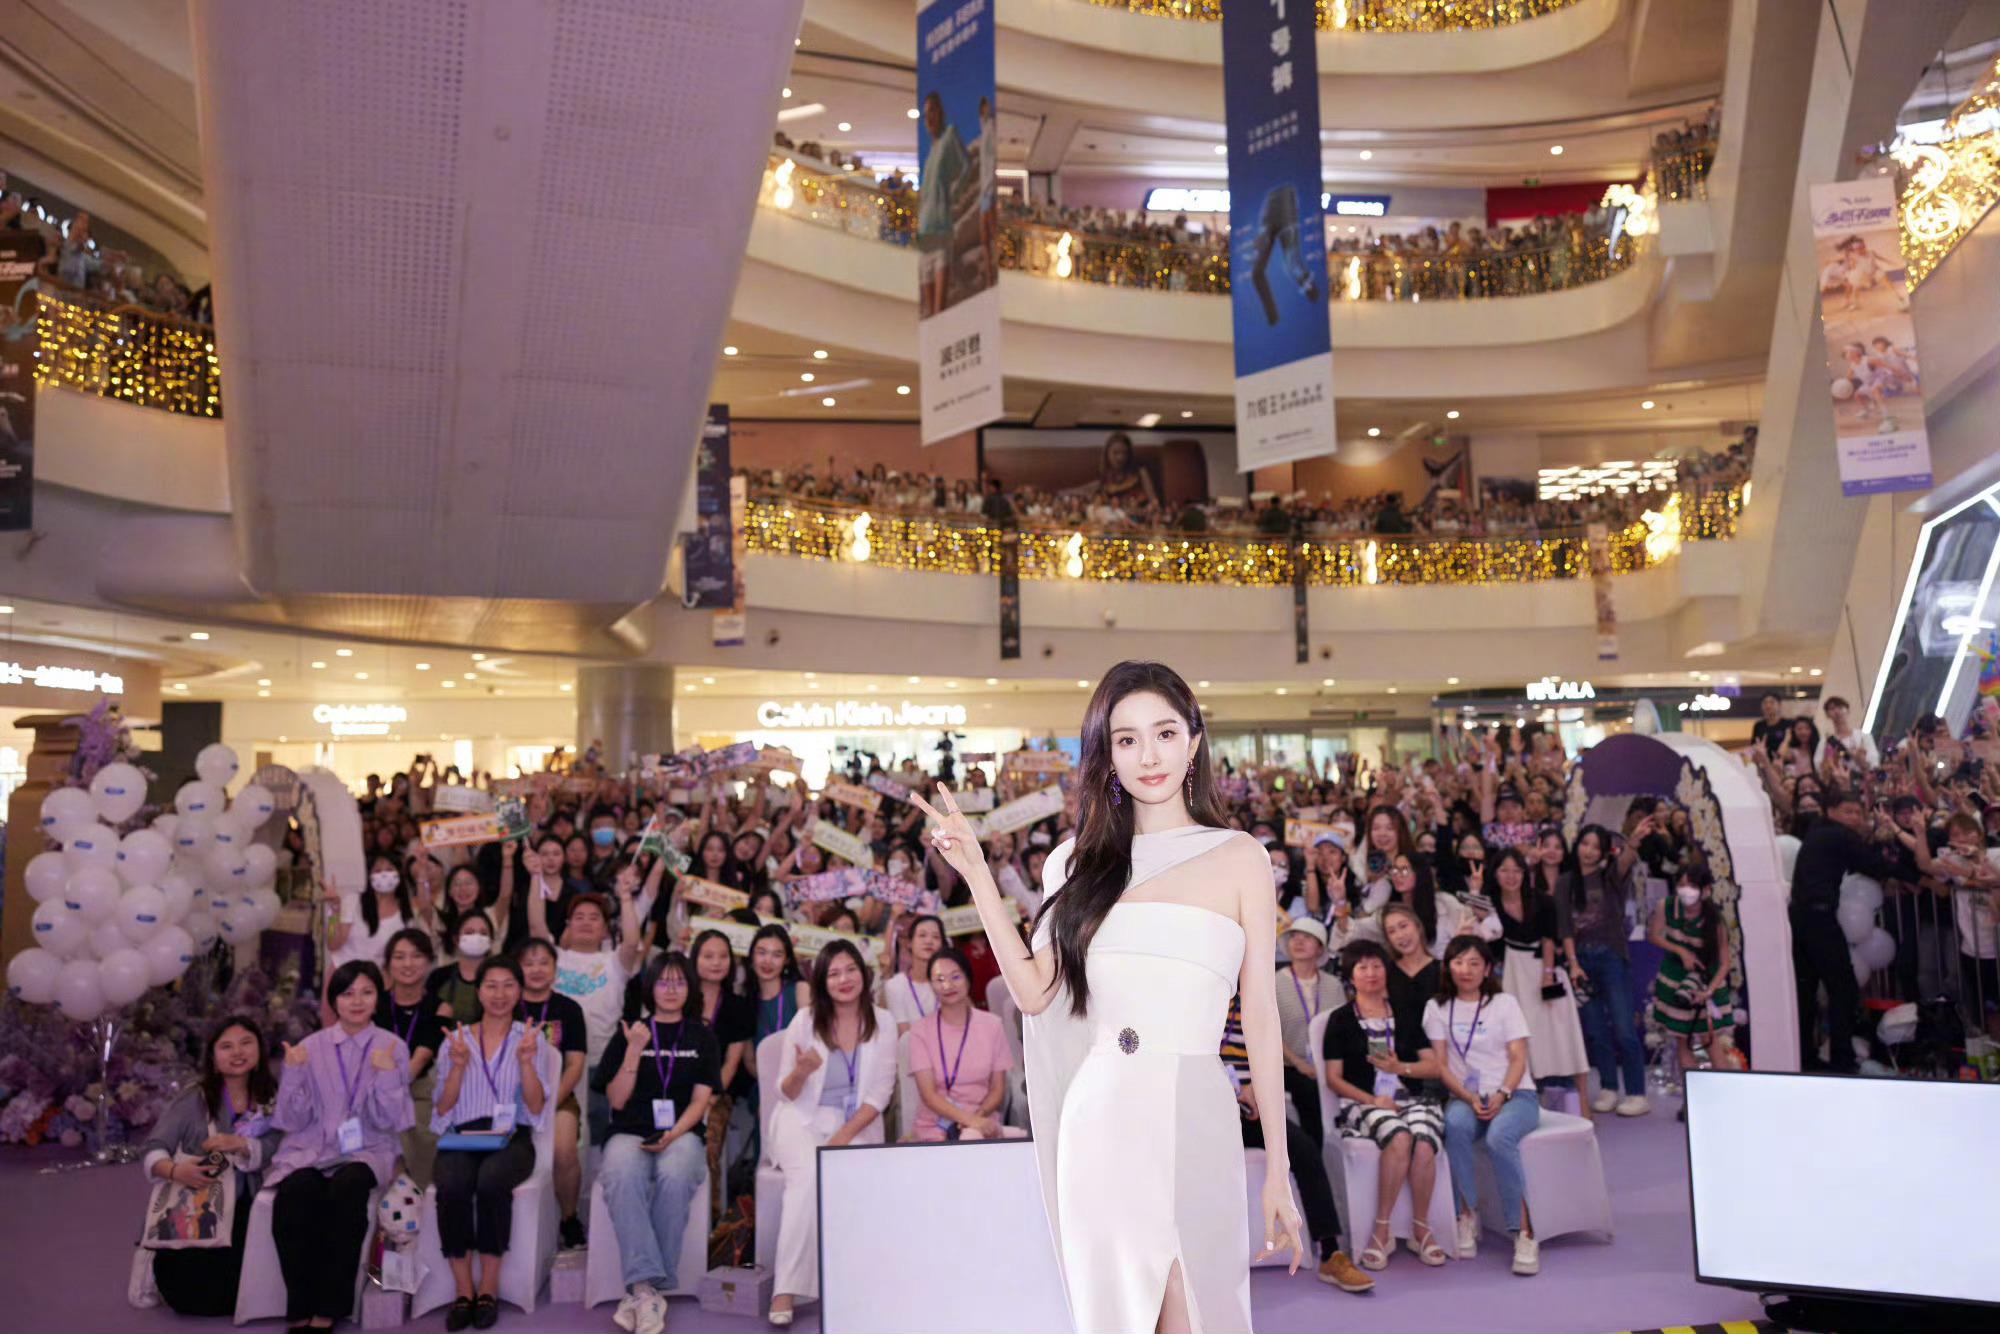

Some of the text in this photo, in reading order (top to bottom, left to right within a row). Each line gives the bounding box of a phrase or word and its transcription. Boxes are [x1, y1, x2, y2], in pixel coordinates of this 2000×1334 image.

[757, 701, 966, 727] Calvin Klein Jeans
